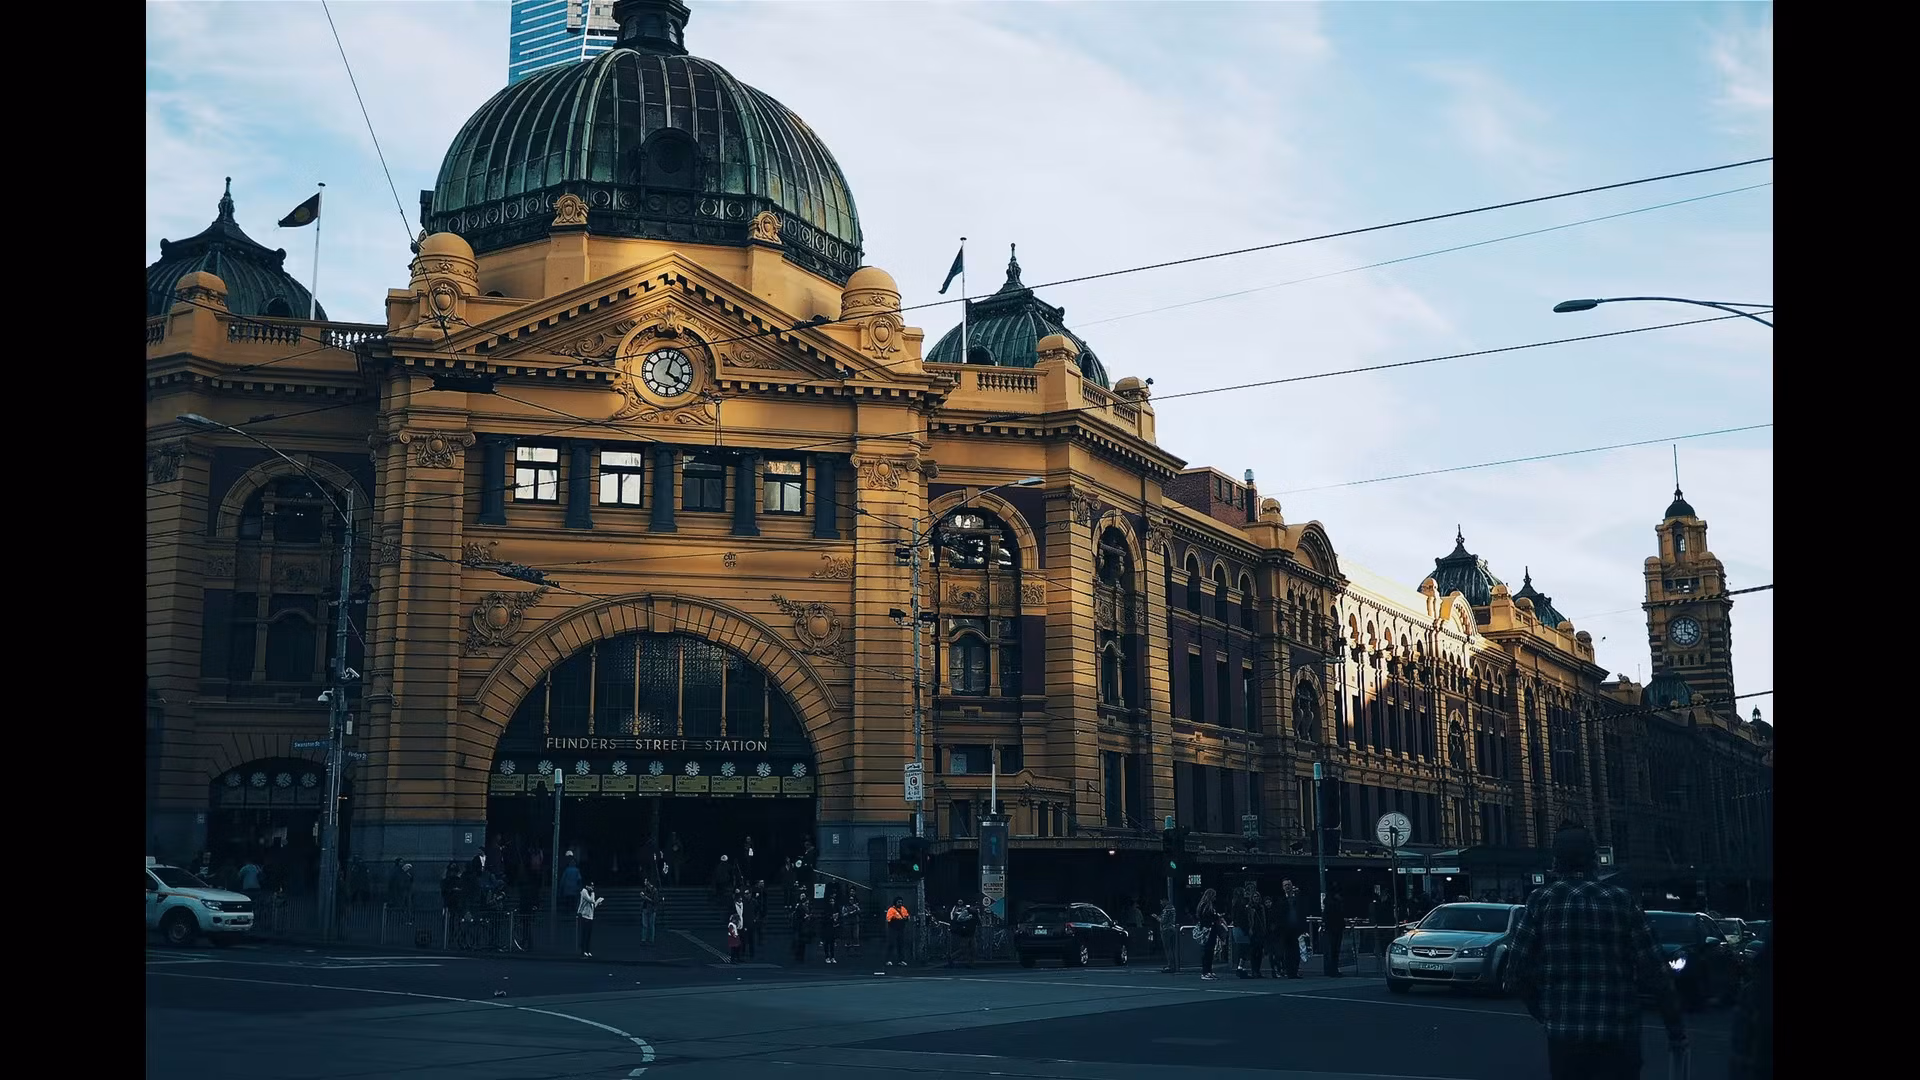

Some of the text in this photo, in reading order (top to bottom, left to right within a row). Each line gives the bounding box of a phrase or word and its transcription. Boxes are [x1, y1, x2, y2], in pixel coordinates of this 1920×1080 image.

[546, 737, 768, 752] FLINDERS STREET STATION
